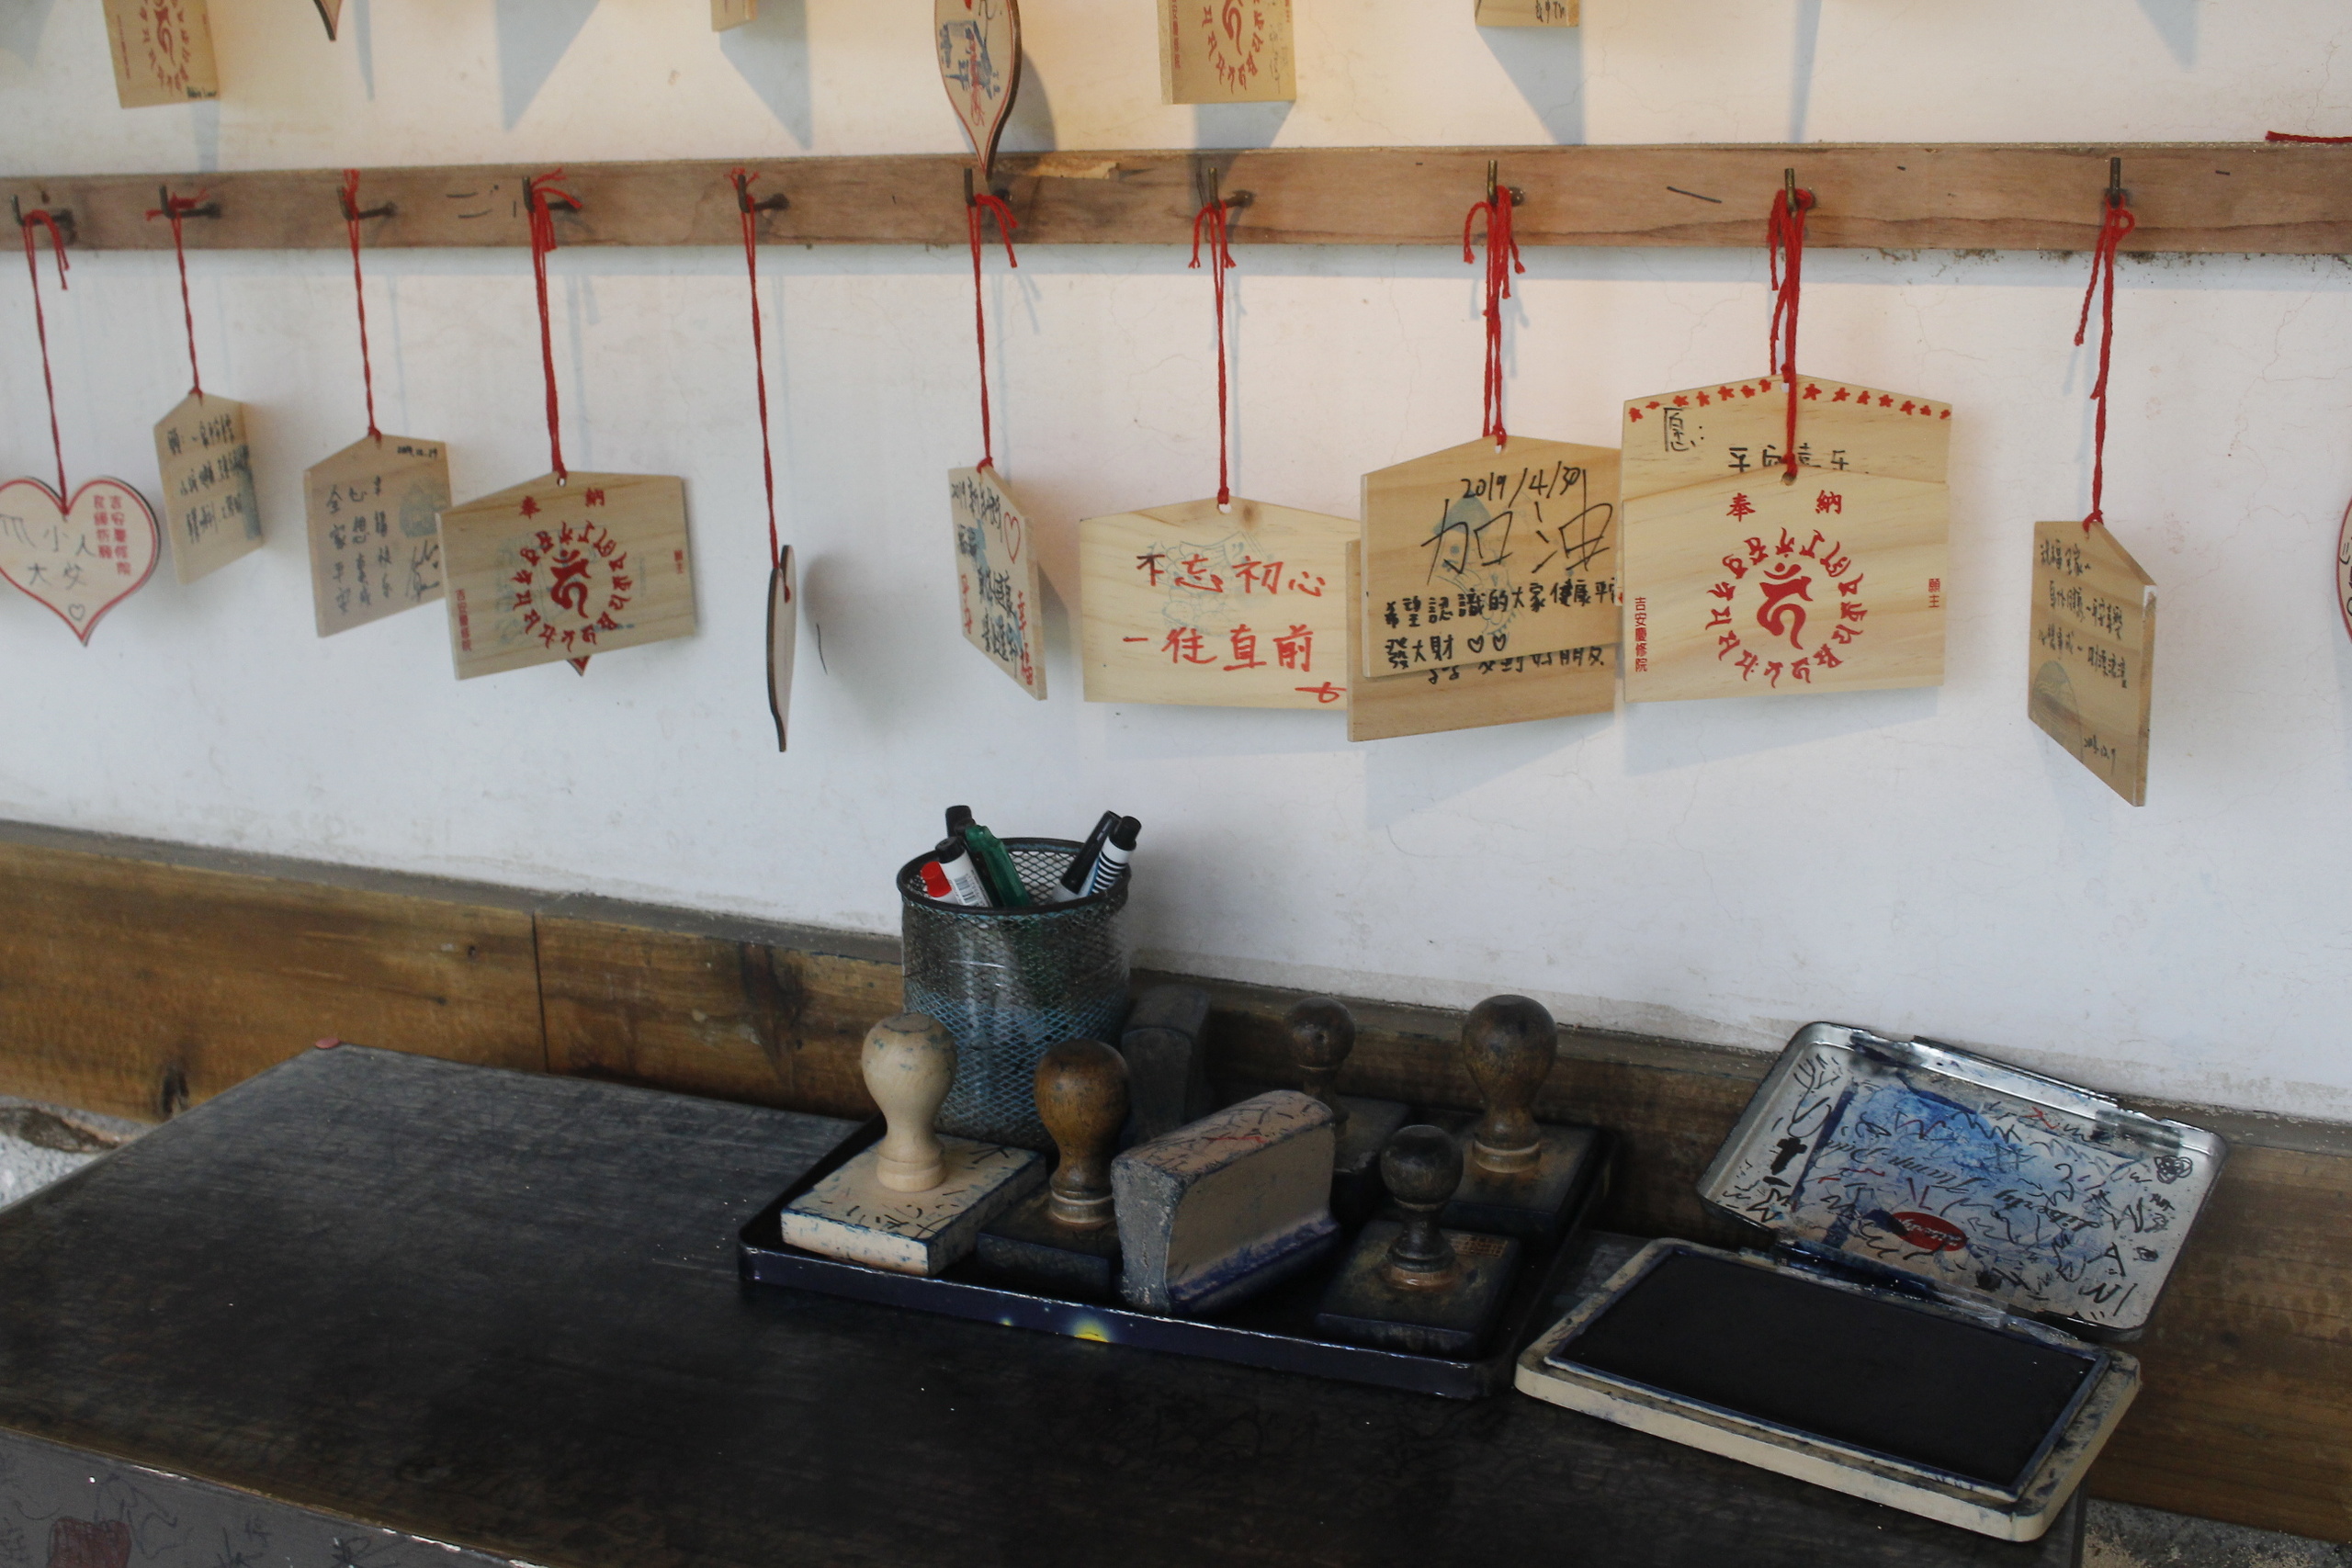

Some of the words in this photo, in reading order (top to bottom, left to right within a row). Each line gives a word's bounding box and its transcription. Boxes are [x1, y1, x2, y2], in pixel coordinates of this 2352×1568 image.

[1461, 461, 1581, 508] 2019/4/30
[1726, 492, 1756, 522] 奉
[1815, 490, 1842, 514] 納
[1420, 469, 1613, 586] 加油
[1136, 553, 1326, 597] 不忘初心
[1928, 578, 1940, 608] 願主
[1123, 624, 1315, 672] 一往直前
[1385, 635, 1454, 670] 發大財
[1634, 596, 1648, 672] 吉安慶修院
[1992, 1188, 2101, 1233] Liberty
